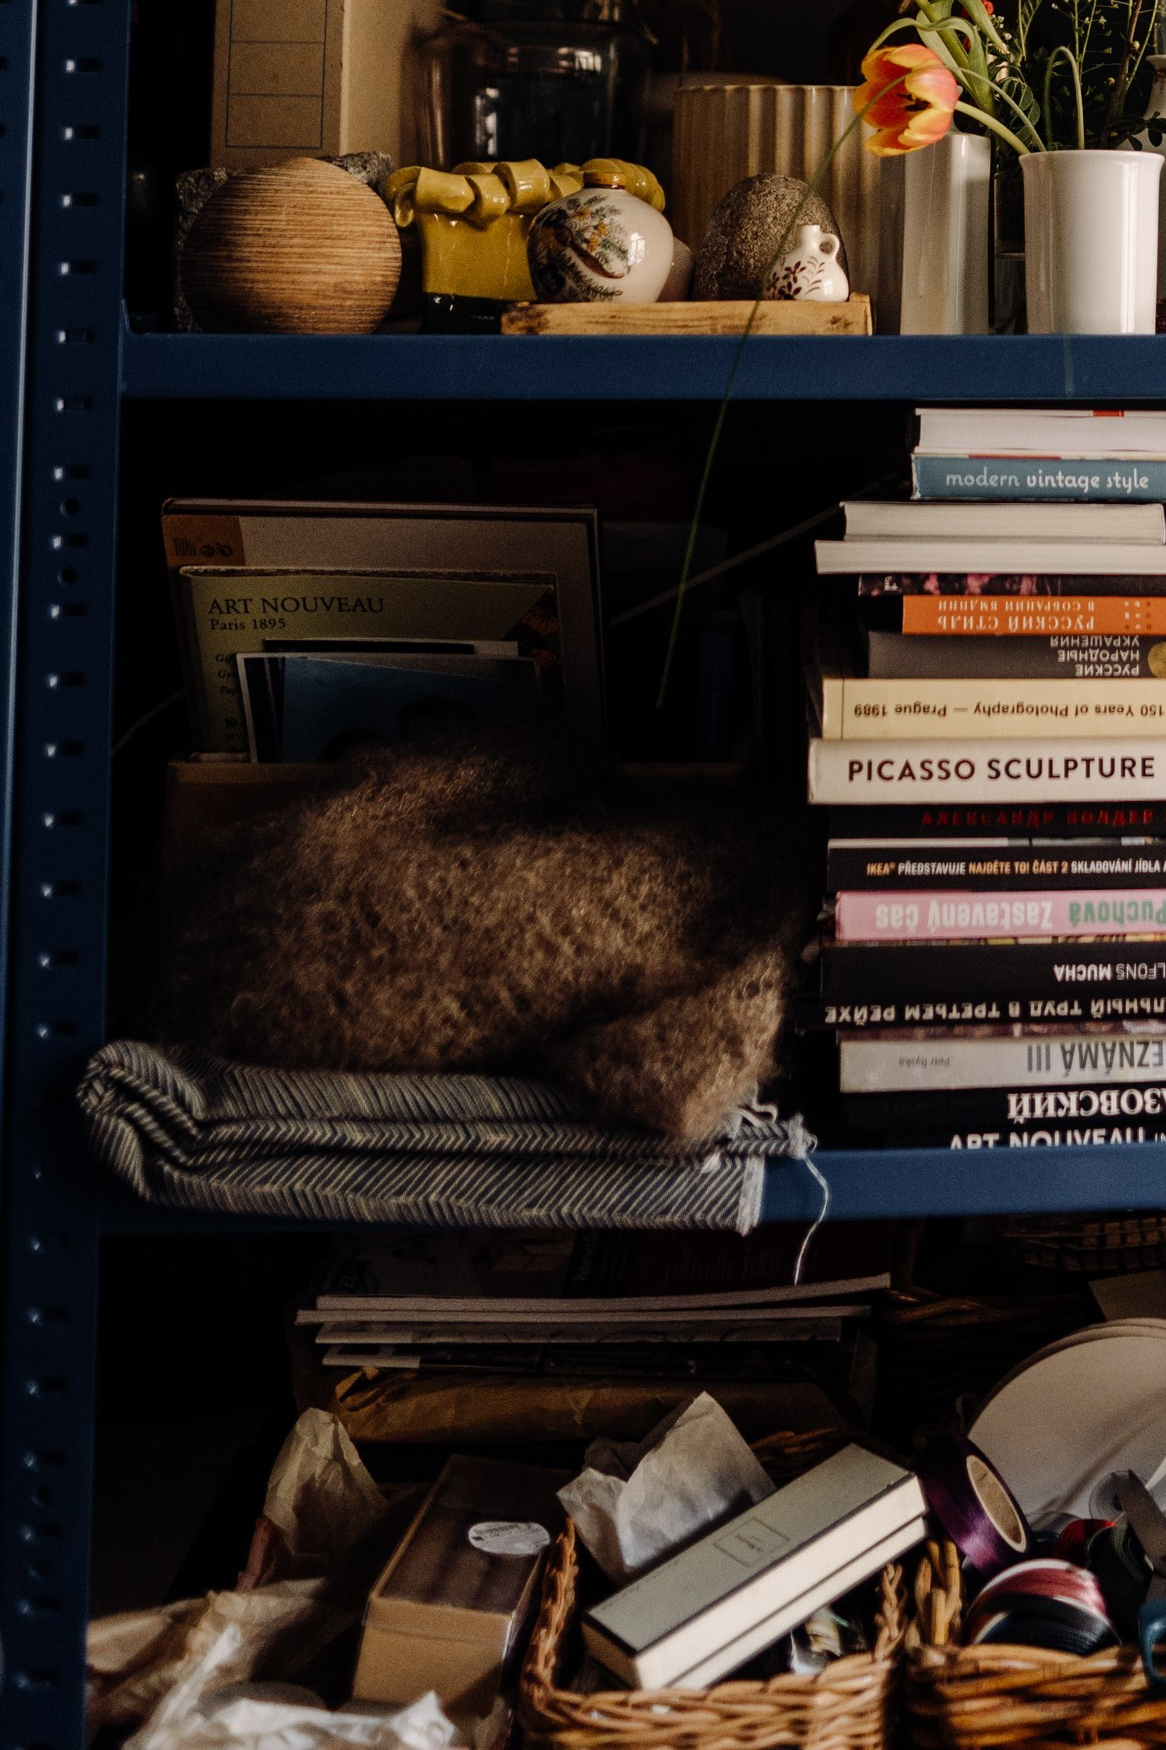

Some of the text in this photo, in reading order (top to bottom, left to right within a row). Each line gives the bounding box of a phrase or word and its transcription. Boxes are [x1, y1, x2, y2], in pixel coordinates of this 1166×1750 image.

[946, 469, 1149, 493] modern vintage style
[208, 597, 384, 615] ART NOUVEAU
[1003, 600, 1080, 610] СОБРАНИИ
[1086, 600, 1094, 610] В
[211, 618, 286, 631] Paris 1895
[937, 615, 1094, 633] РУССКИЙ СТИЛЬ
[1050, 635, 1139, 647] УКРАШЕНИЯ
[1058, 649, 1139, 661] НАРОДНЫЕ
[1075, 665, 1139, 675] РУССКИЕ
[854, 701, 1164, 717] 150 Years of Photography Prague 1989
[848, 756, 1154, 782] PICASSO SCULPTURE
[898, 860, 965, 875] PŘEDSTAVUJE
[969, 860, 1010, 874] NAJDĚTE
[1014, 862, 1030, 874] TO!
[1032, 859, 1058, 874] ČÁST
[1061, 862, 1068, 873] 2
[1071, 859, 1132, 874] SKLADOVÁNÍ
[1134, 859, 1160, 873] JÍDLA
[875, 903, 919, 933] čas
[928, 899, 1053, 931] Zastavený
[1053, 964, 1112, 981] MUCHA
[824, 1005, 895, 1024] РЕЙХЕ
[905, 1001, 1000, 1019] ТРЕТЬЕМ
[1008, 1001, 1020, 1016] В
[1029, 998, 1081, 1015] ТРУД
[1027, 1045, 1051, 1072] III
